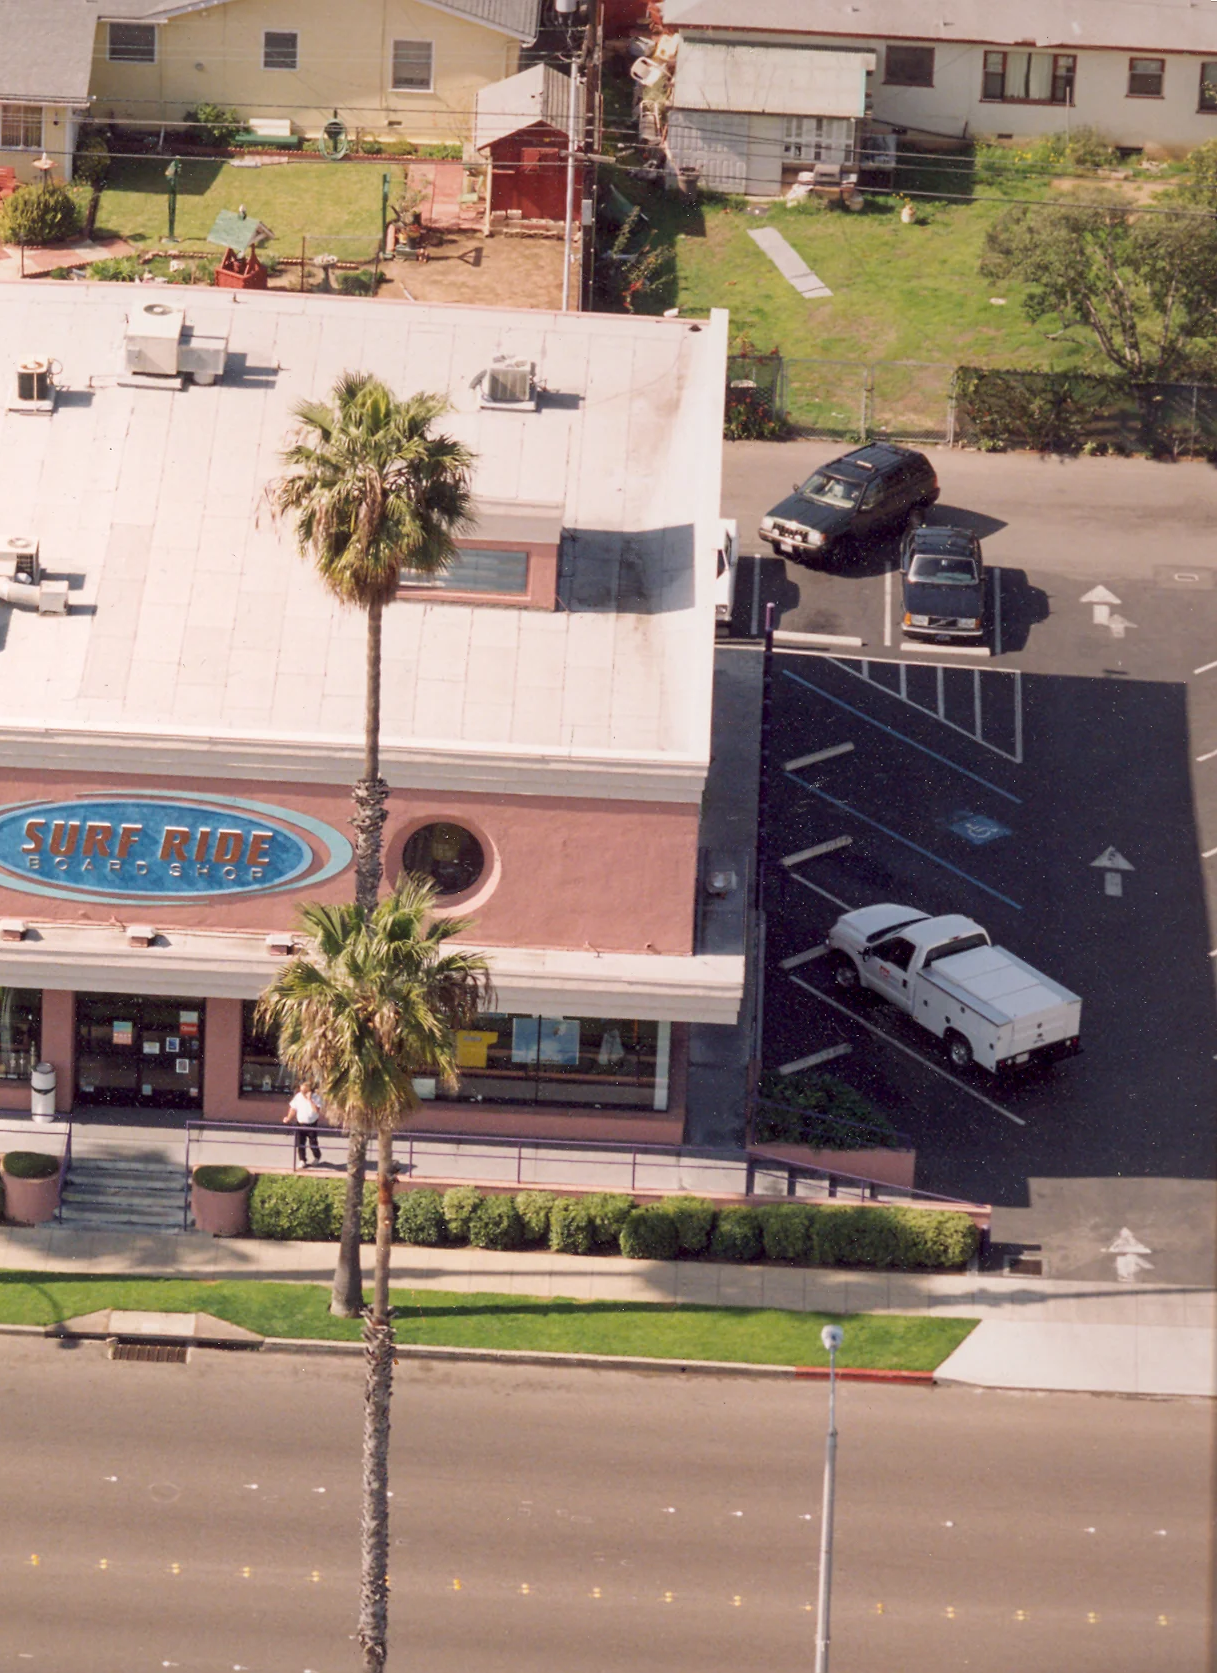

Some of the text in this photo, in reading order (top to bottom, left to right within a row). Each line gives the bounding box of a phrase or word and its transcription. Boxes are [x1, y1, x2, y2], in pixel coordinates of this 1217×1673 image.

[21, 819, 274, 866] SURF RIDE
[28, 855, 264, 881] BOARD SHOP
